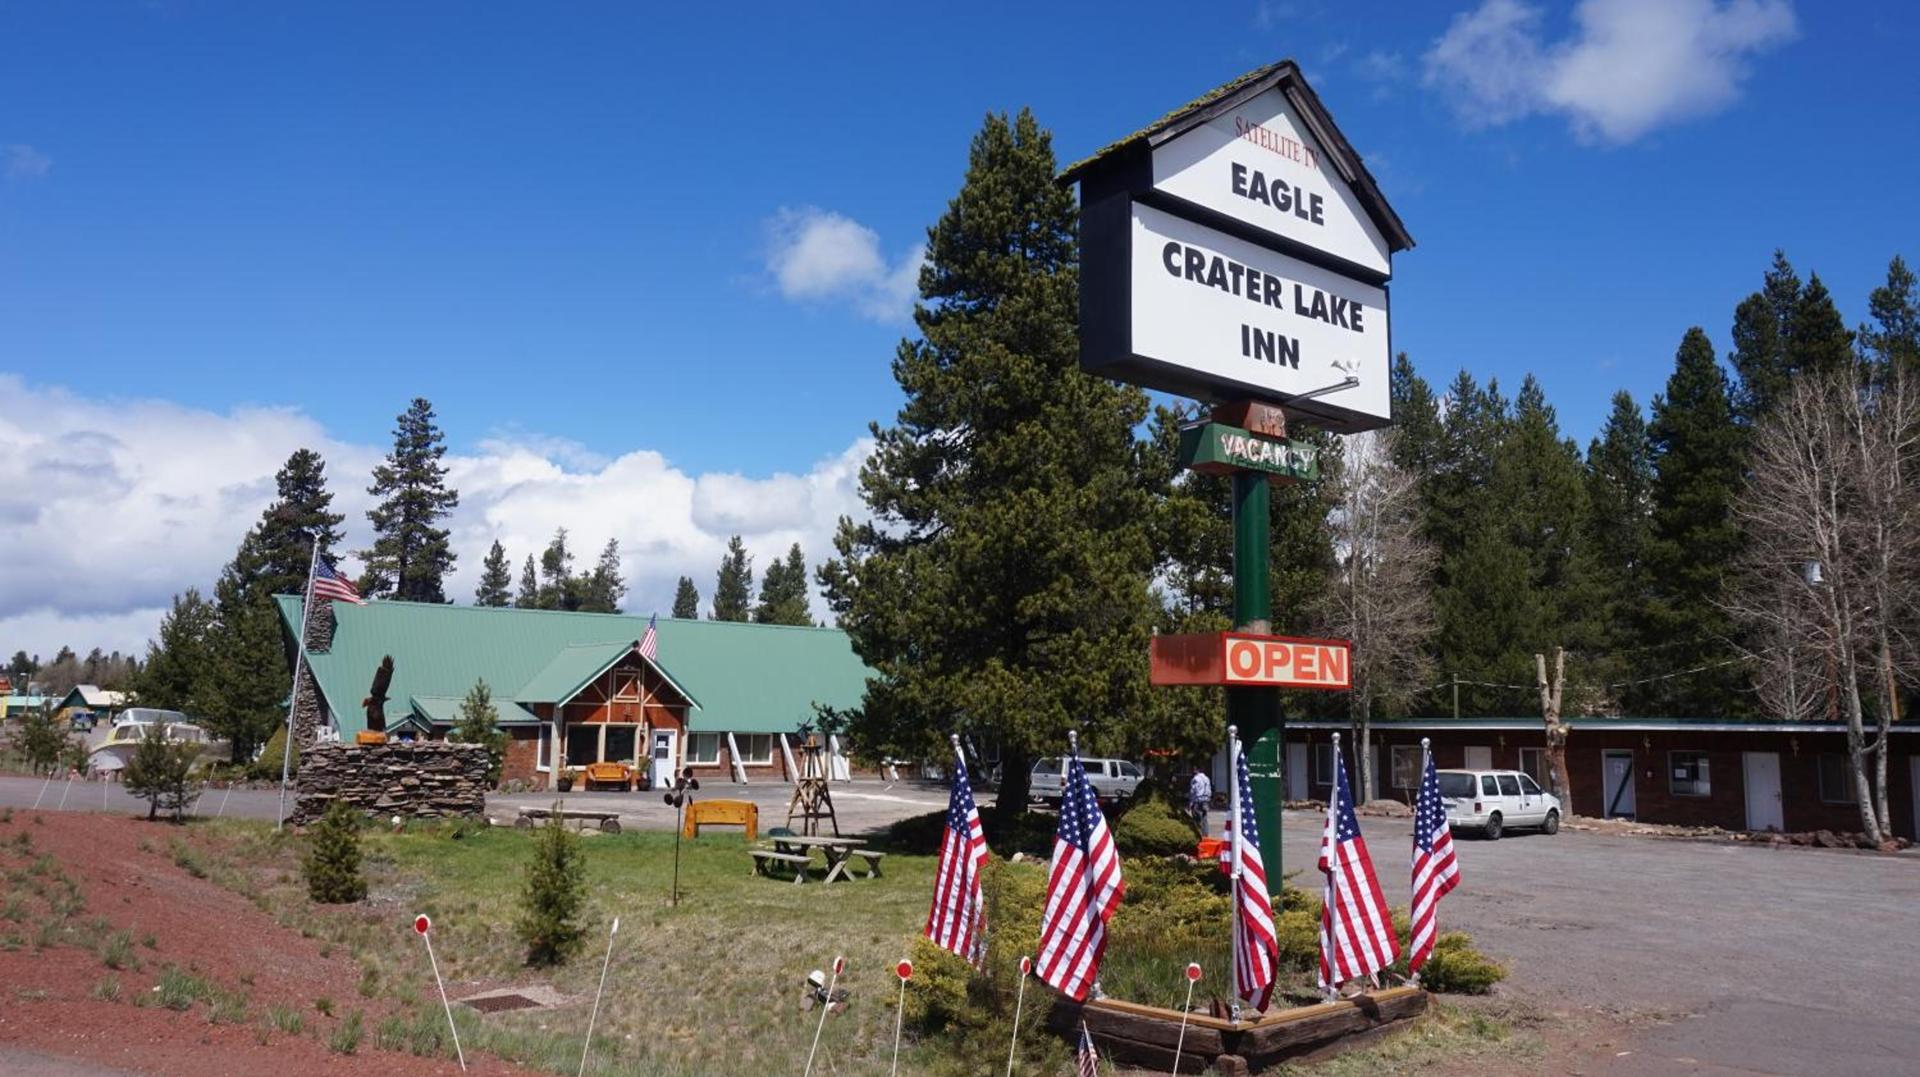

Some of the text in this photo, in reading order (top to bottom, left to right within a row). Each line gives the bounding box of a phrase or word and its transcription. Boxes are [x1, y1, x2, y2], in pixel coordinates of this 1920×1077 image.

[1235, 115, 1319, 169] SATELLITE TV
[1231, 161, 1324, 226] EAGLE
[1162, 242, 1364, 332] CRATER LAKE
[1241, 324, 1300, 369] INN
[1220, 433, 1316, 472] VACANCY
[1229, 641, 1344, 681] OPEN
